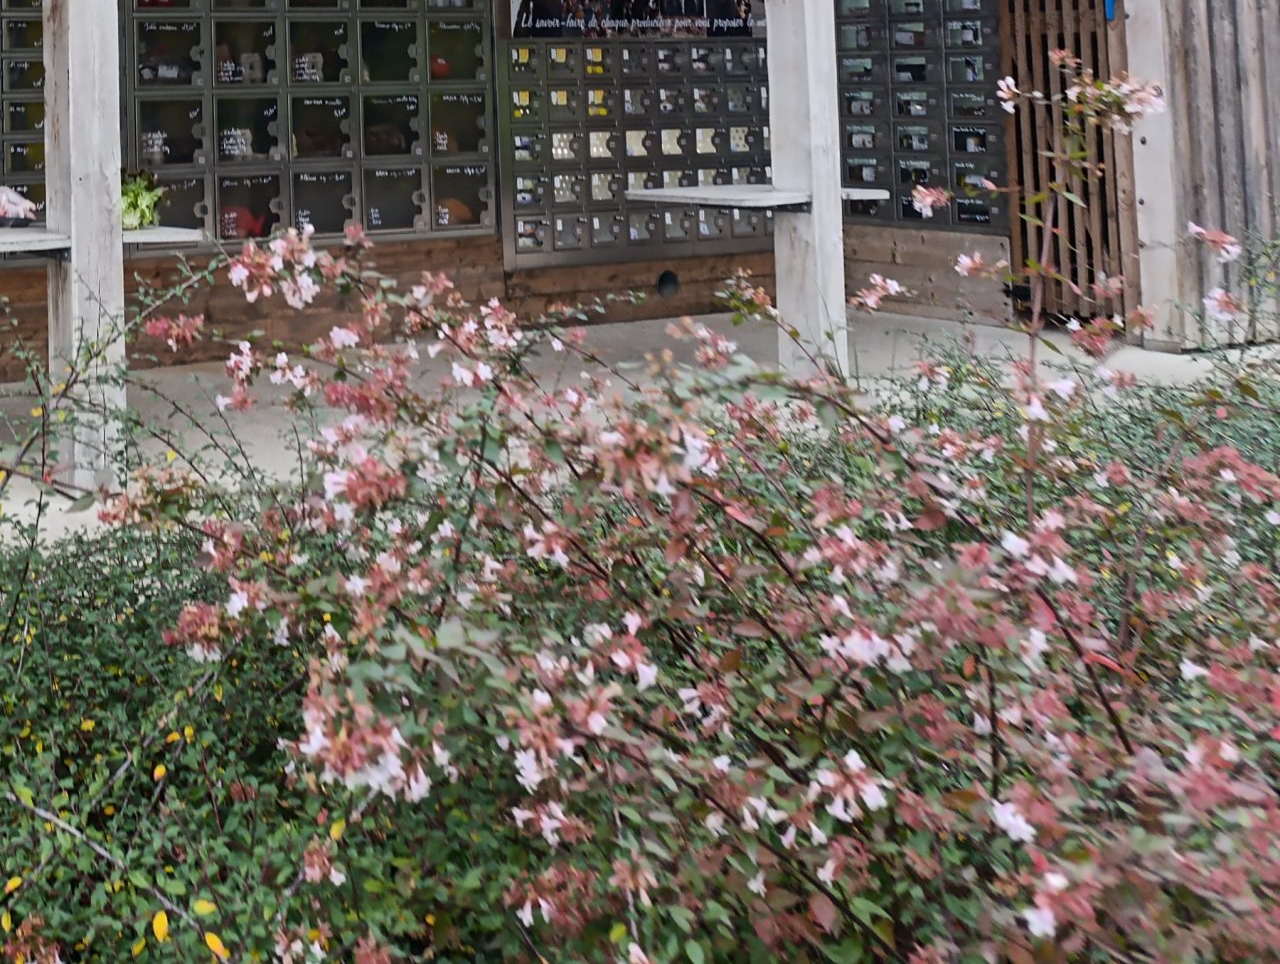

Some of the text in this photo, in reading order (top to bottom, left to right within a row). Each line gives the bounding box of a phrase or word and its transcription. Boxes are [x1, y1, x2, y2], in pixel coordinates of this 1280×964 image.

[521, 12, 533, 27] Le
[535, 13, 585, 30] savoir-faire
[588, 13, 600, 29] de
[601, 14, 629, 31] chaque
[631, 14, 672, 32] producteur
[674, 17, 692, 32] pour
[695, 17, 710, 28] vous
[712, 17, 744, 32] proposer
